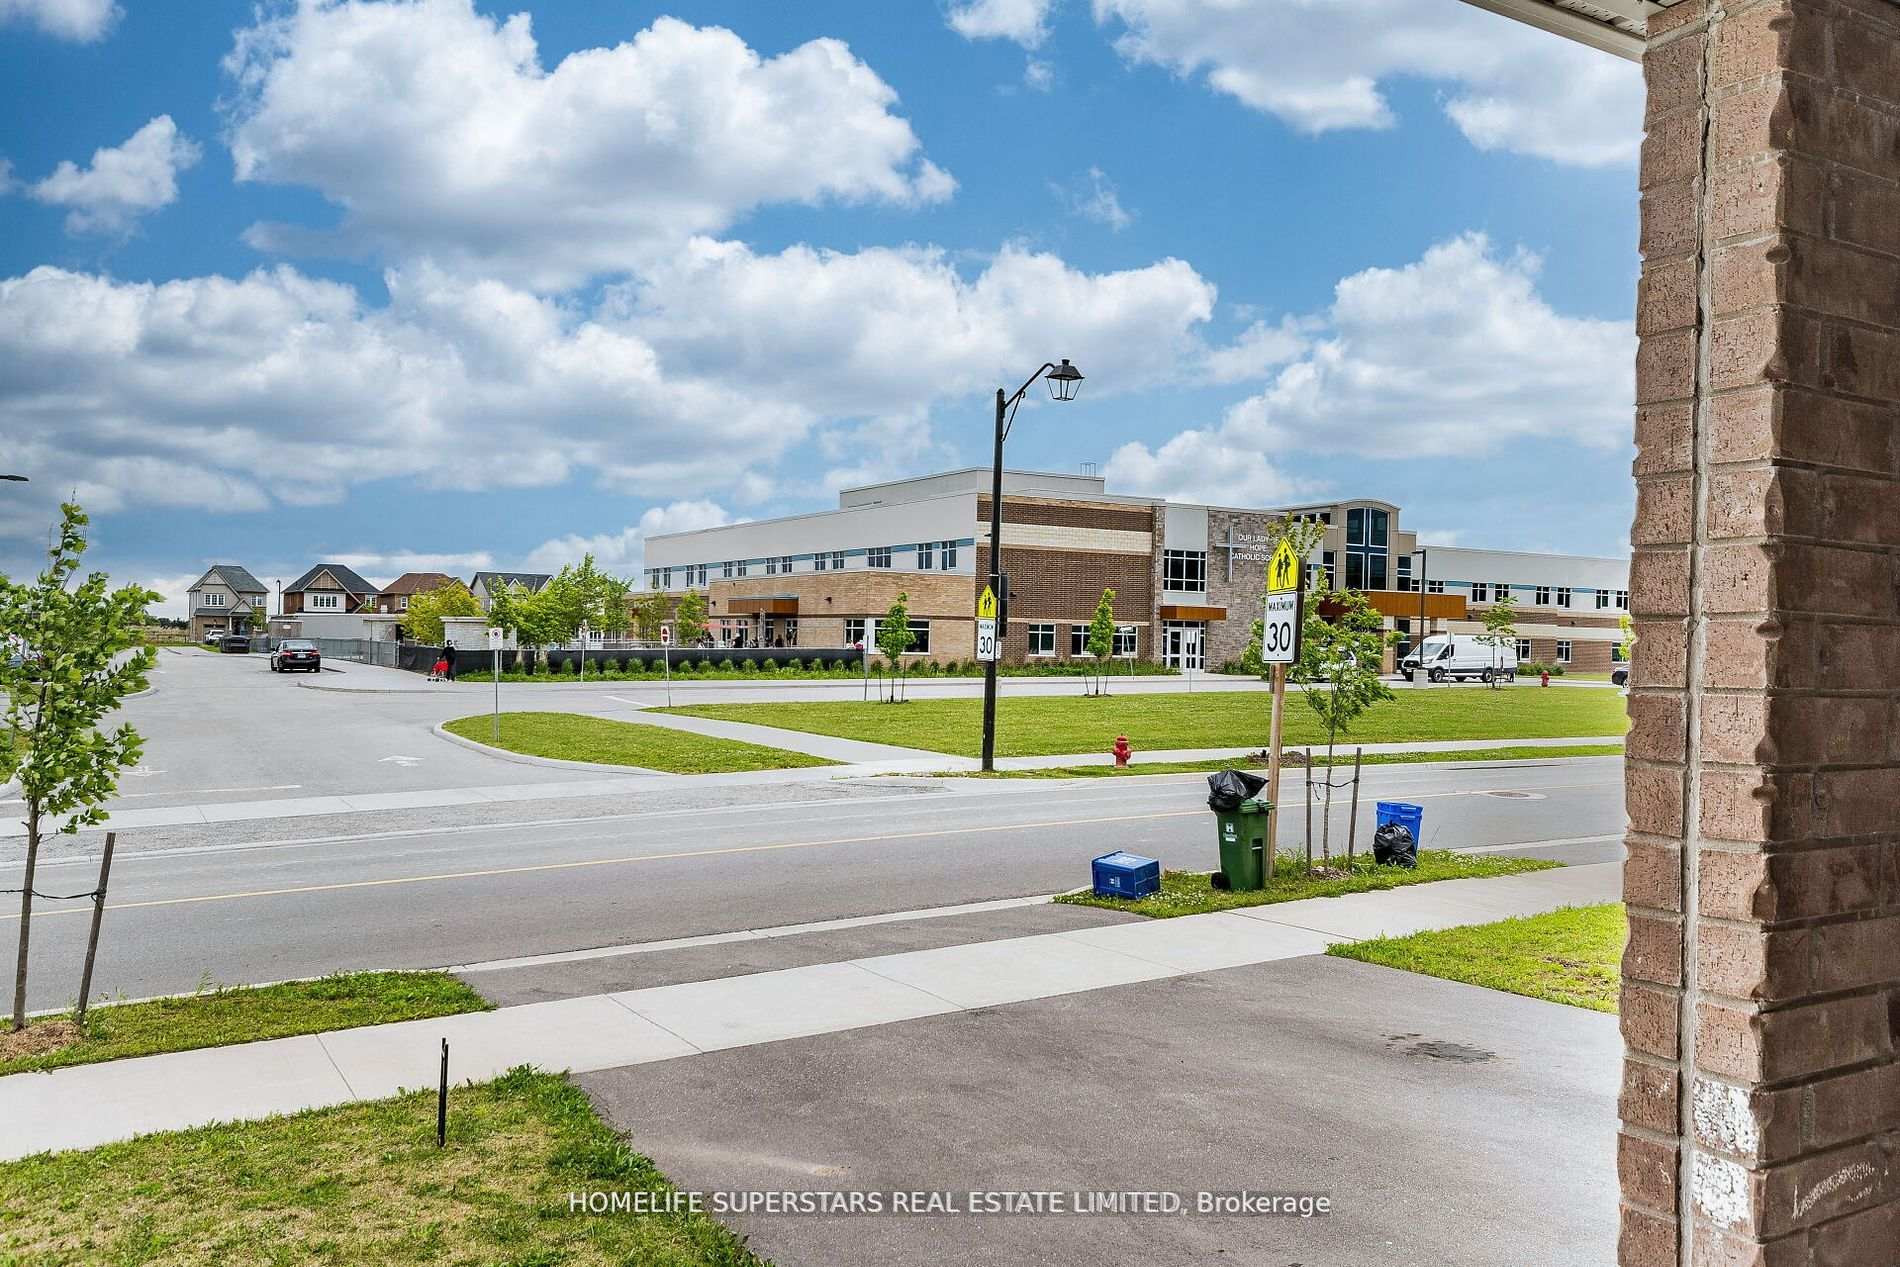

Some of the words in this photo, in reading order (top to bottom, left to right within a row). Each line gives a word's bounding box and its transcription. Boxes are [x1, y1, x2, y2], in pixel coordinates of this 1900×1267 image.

[1238, 533, 1252, 542] OUR
[1231, 552, 1260, 561] CATHOLIC
[1267, 621, 1291, 652] 30
[979, 636, 993, 654] 30
